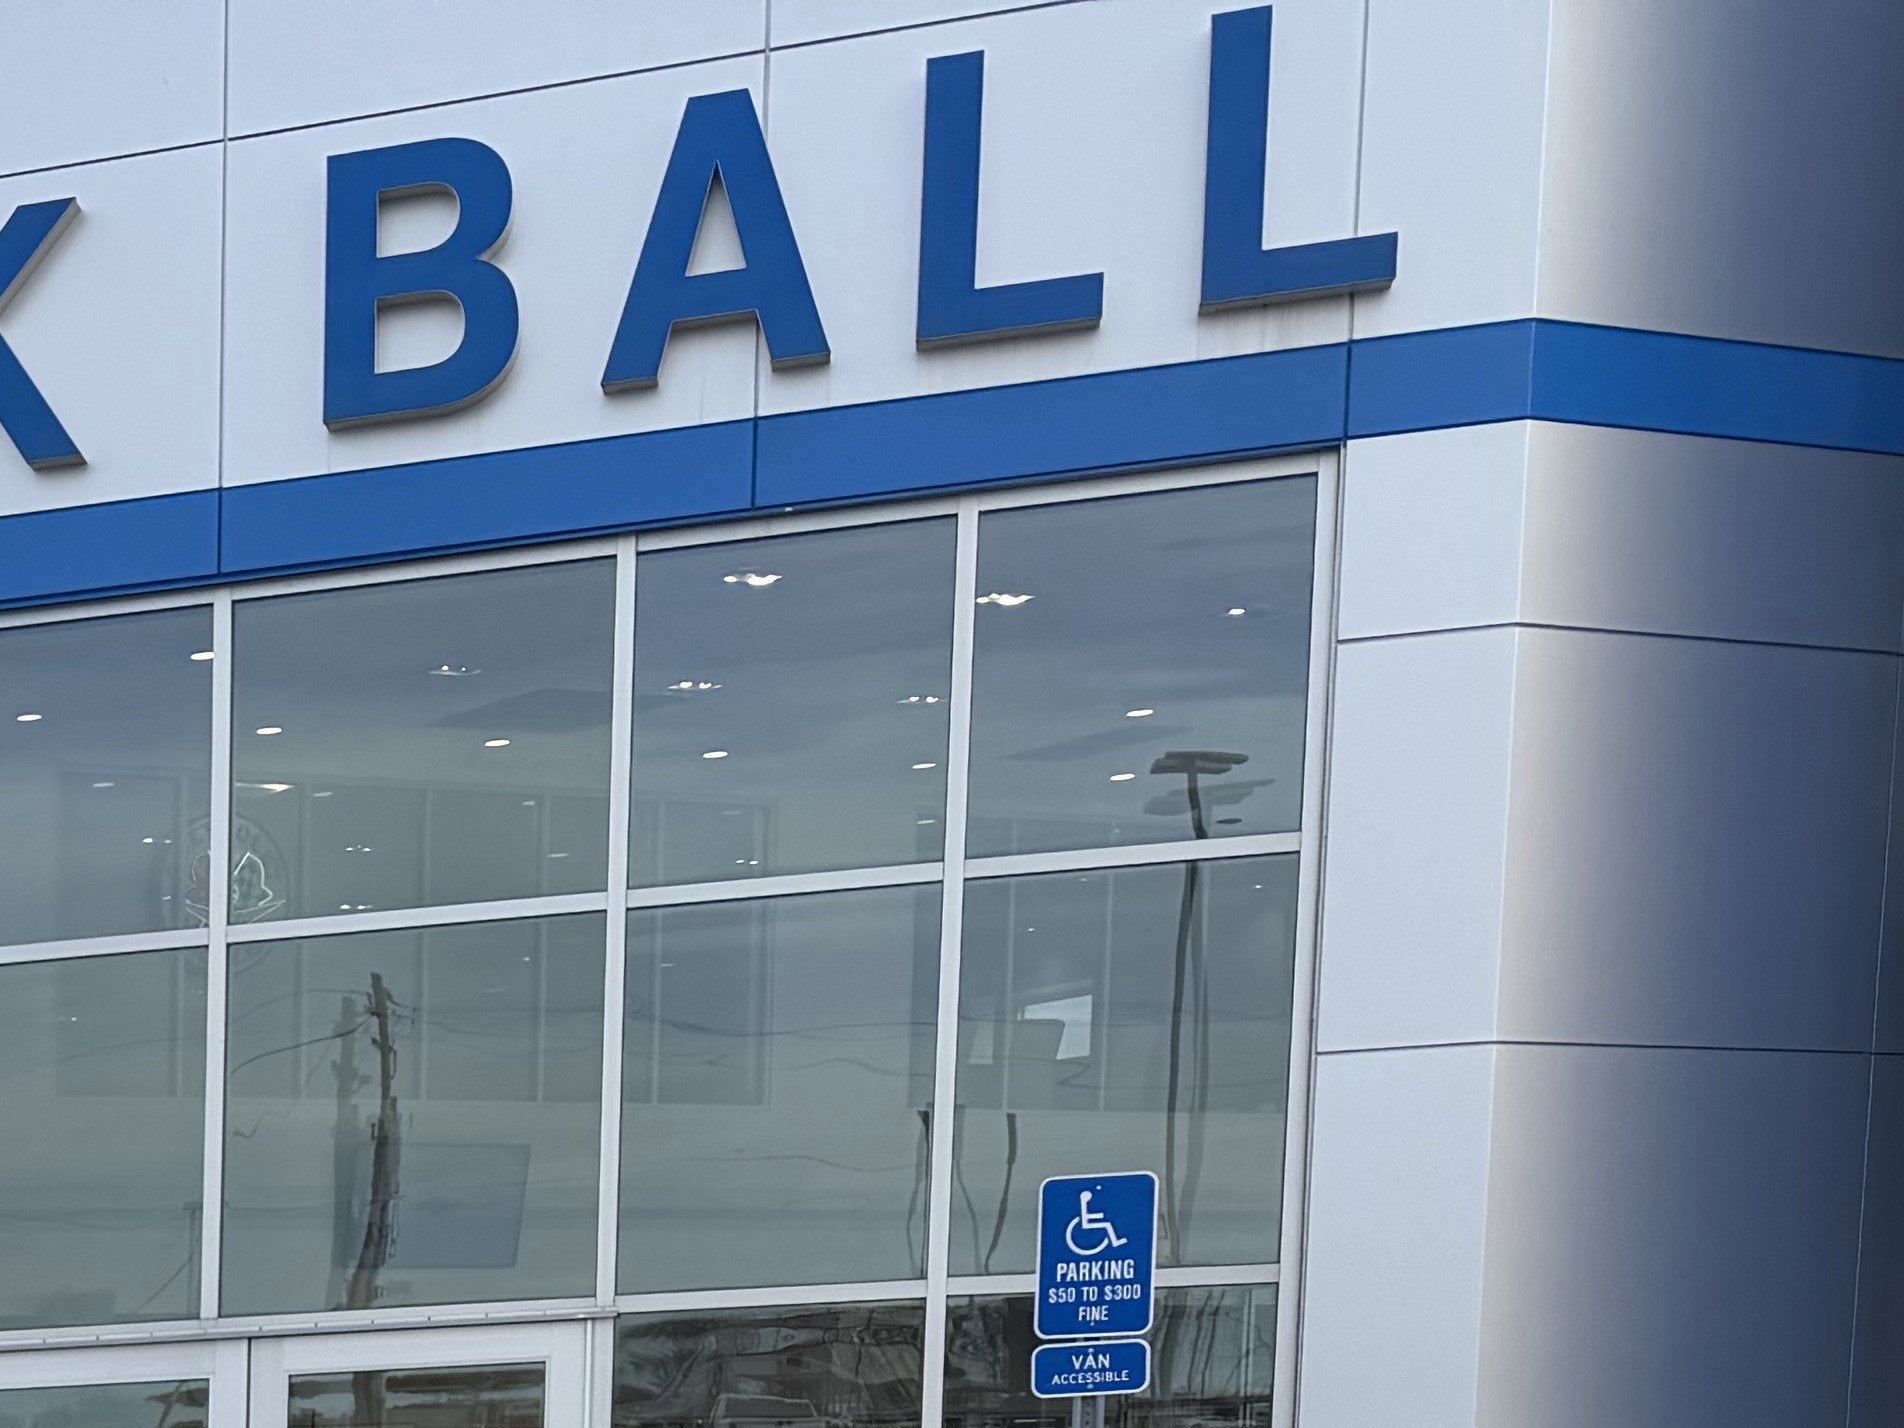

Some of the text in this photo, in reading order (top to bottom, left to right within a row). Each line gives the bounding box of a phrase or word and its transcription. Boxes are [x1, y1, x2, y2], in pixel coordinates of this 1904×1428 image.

[320, 4, 1400, 432] BALL
[1056, 1259, 1134, 1282] PARKING
[1049, 1284, 1141, 1304] $50 TO $300
[1078, 1305, 1109, 1322] FINE
[1072, 1353, 1110, 1370] VAN
[1051, 1370, 1130, 1386] ACCESSIBLE
